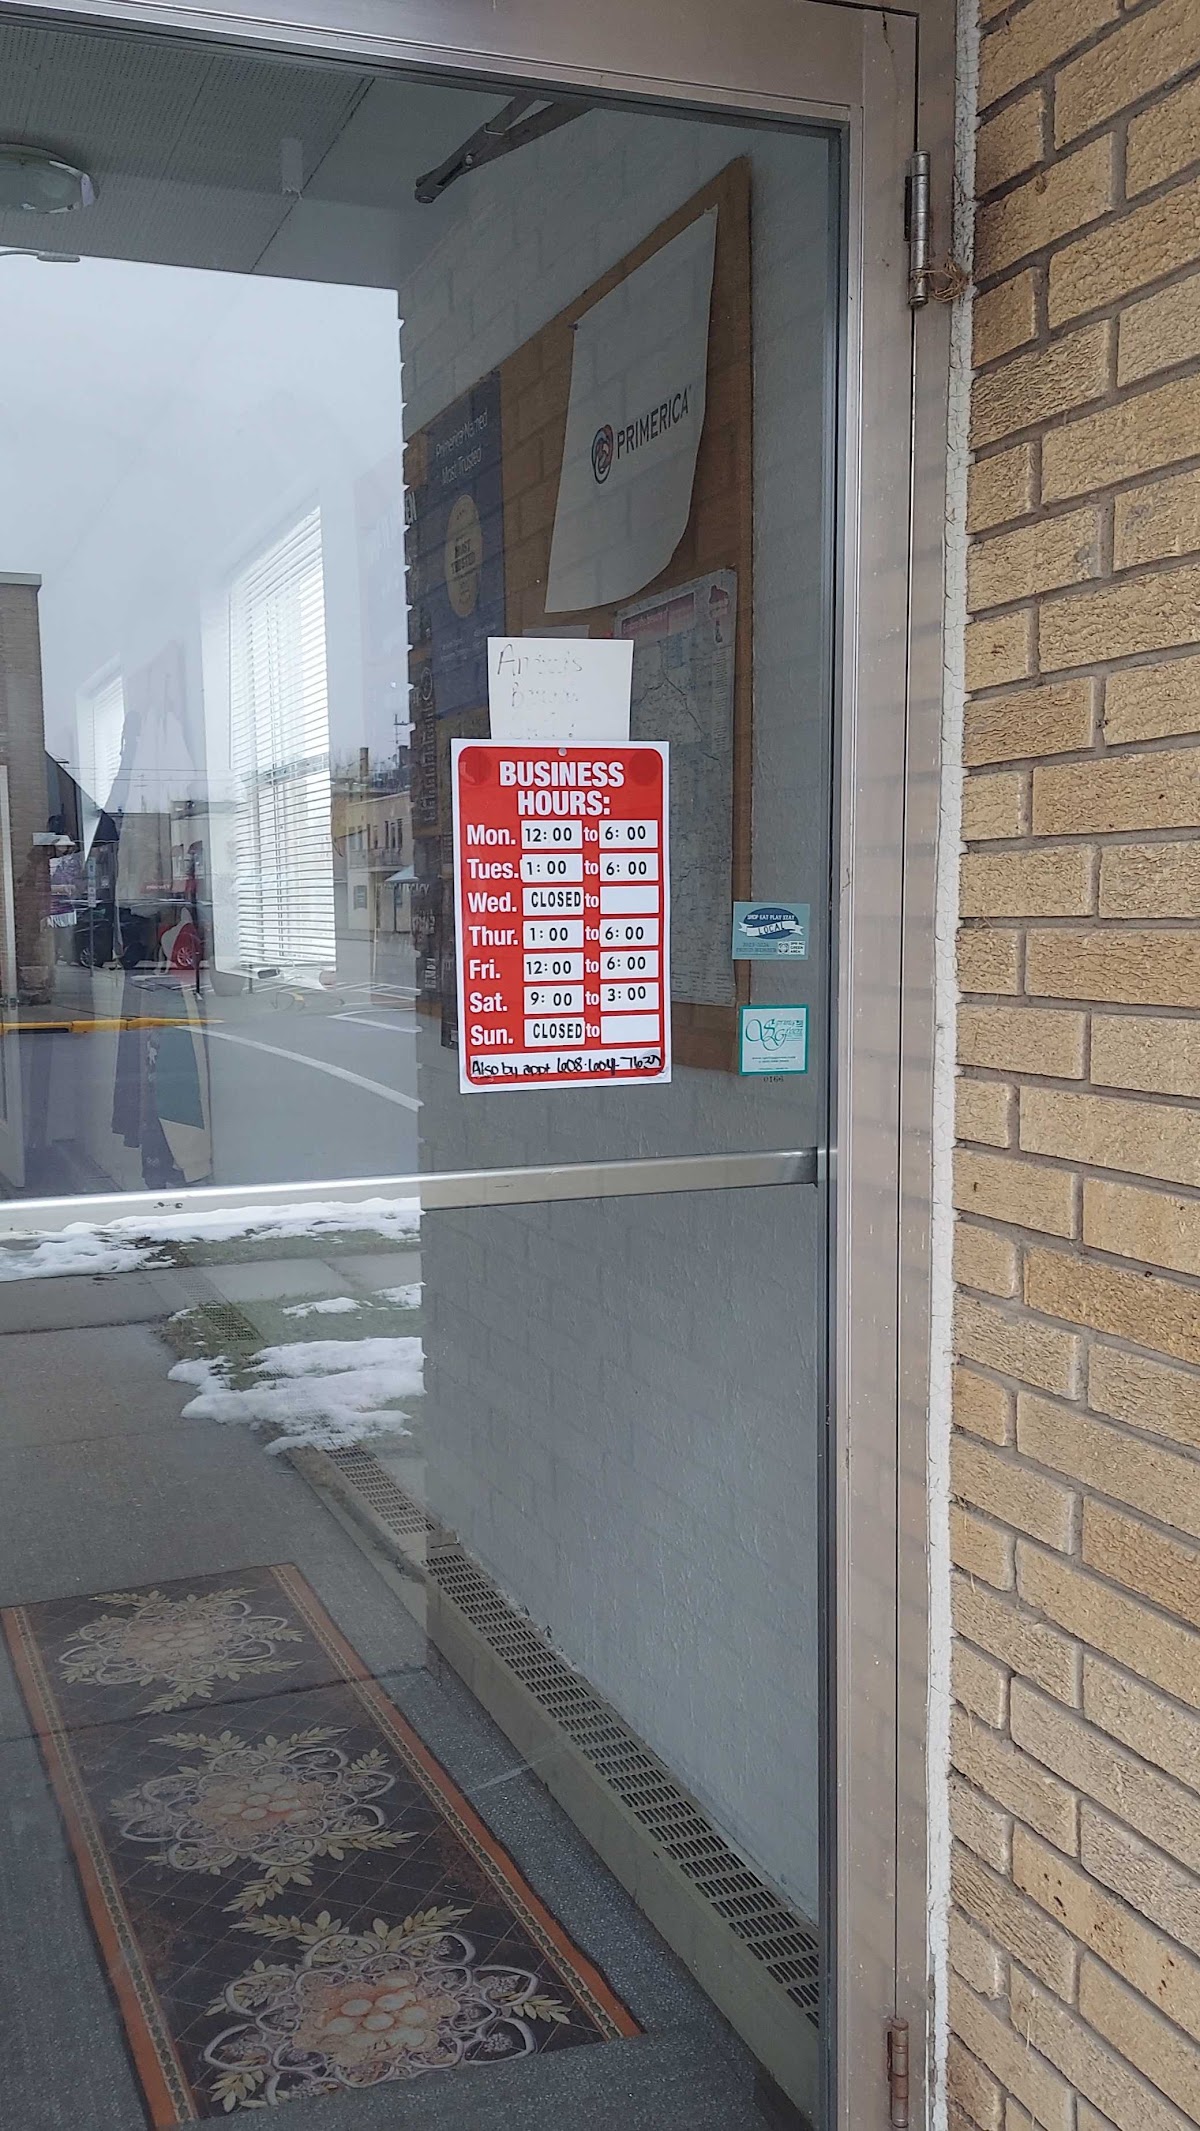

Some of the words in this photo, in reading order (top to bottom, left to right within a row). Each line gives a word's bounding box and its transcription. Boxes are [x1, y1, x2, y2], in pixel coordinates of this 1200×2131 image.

[616, 387, 689, 459] PRIMERICA
[499, 761, 625, 787] BUSINESS
[517, 790, 611, 816] HOURS:
[466, 824, 516, 845] Mon.
[583, 826, 598, 842] to
[466, 858, 519, 879] Tues.
[584, 859, 599, 875] to
[467, 891, 517, 913] Wed.
[531, 891, 581, 908] CLOSED
[585, 892, 599, 908] to
[468, 925, 519, 946] Thur.
[585, 925, 599, 941] to
[758, 921, 785, 935] LOCAL
[469, 958, 501, 979] Fri.
[585, 958, 599, 973] to
[469, 991, 508, 1013] Sat.
[585, 990, 599, 1006] to
[470, 1024, 514, 1046] Sun.
[533, 1023, 583, 1039] CLOSED
[586, 1022, 600, 1038] to
[472, 1060, 499, 1076] Also
[501, 1061, 518, 1077] by
